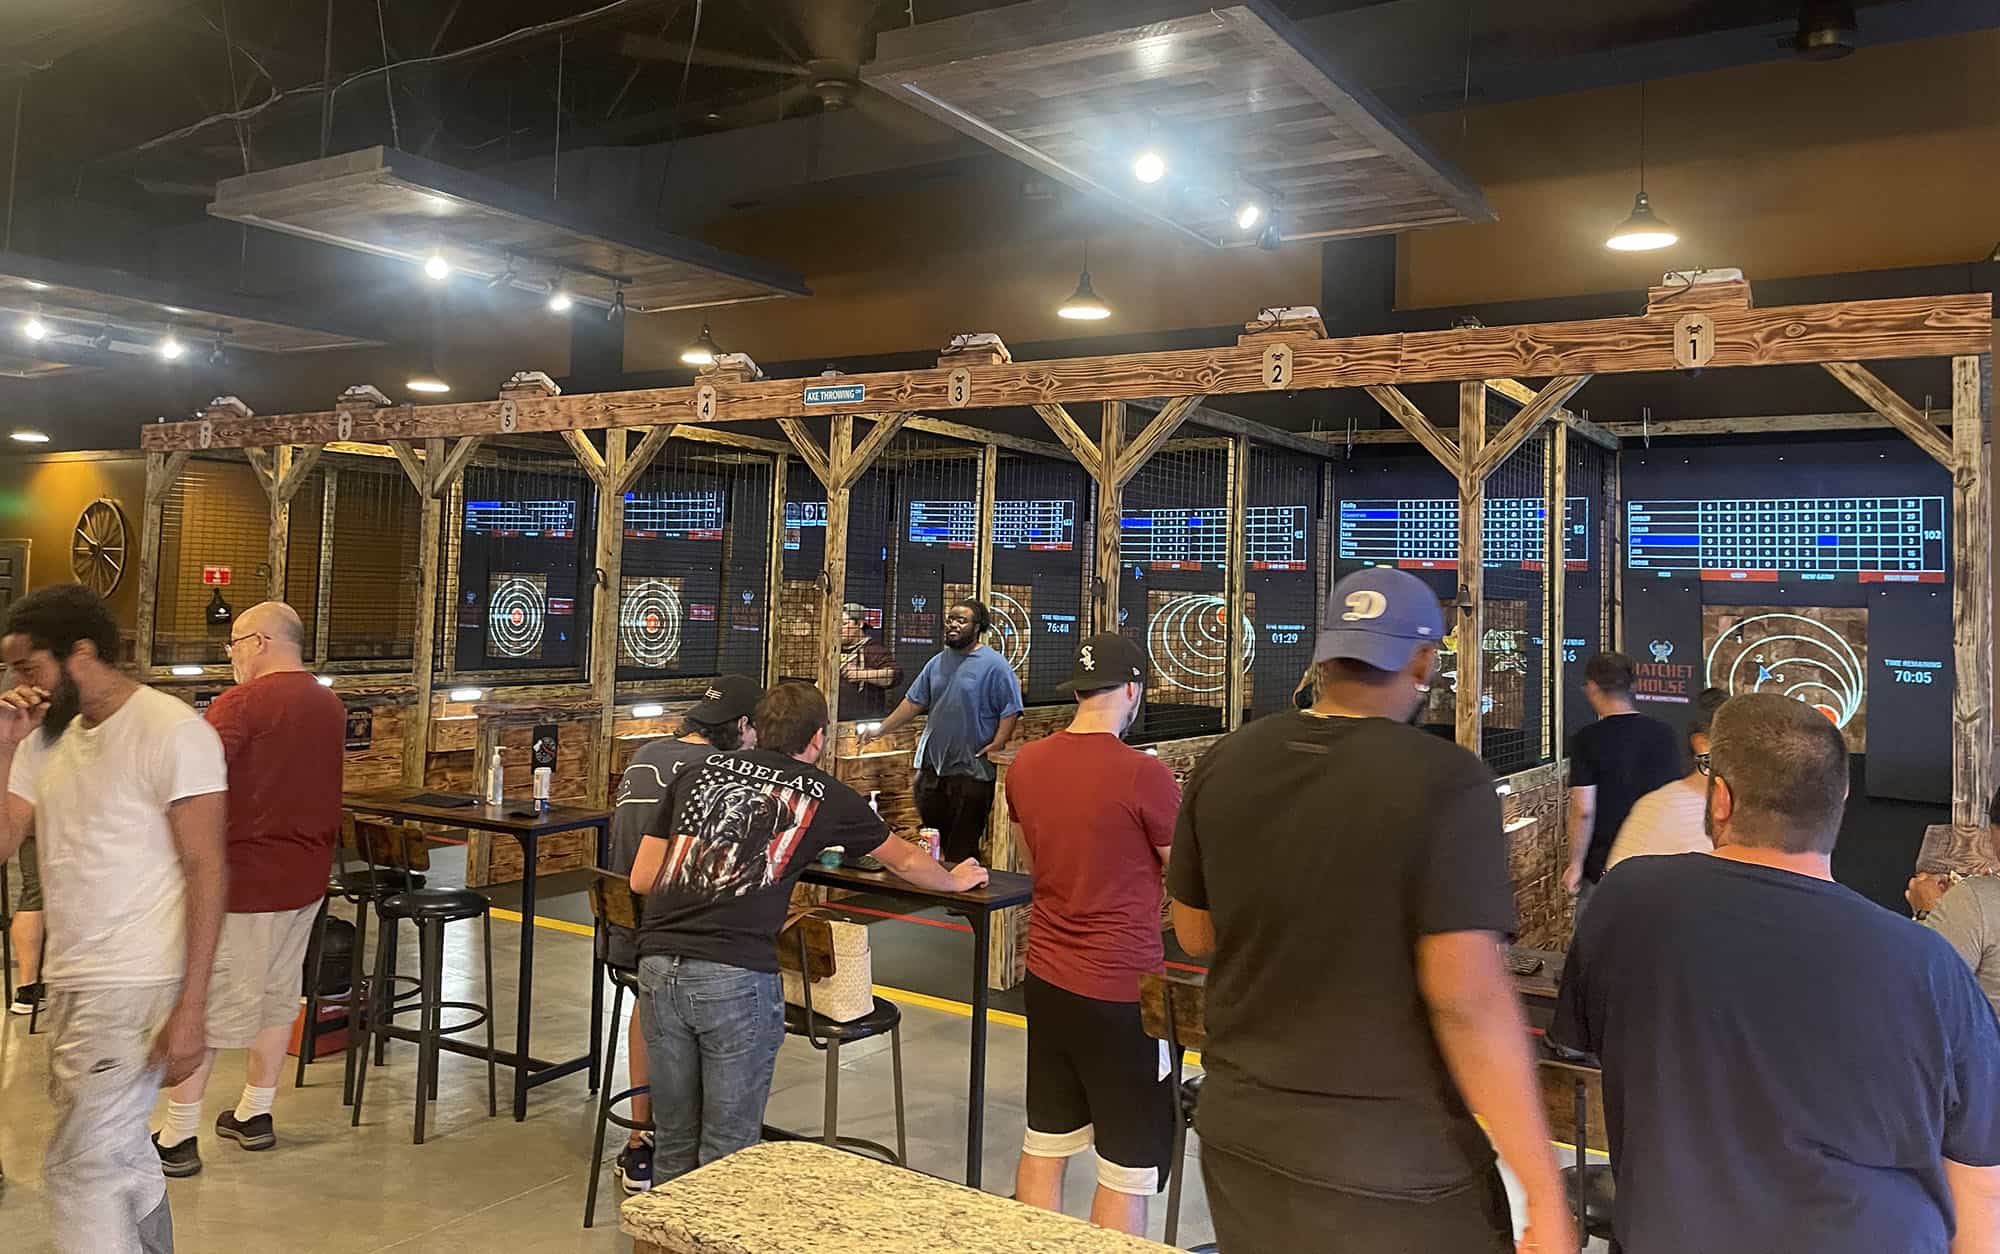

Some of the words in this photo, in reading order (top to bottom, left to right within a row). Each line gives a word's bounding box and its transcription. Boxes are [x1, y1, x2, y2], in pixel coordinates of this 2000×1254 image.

[1688, 338, 1697, 361] 1
[1271, 364, 1283, 383] 2
[806, 391, 820, 401] AXE
[821, 389, 855, 401] THROWING
[954, 386, 963, 402] 3
[702, 401, 710, 416] 4
[504, 414, 511, 427] 5
[1754, 653, 1764, 664] 2
[1775, 673, 1785, 683] 3
[1893, 669, 1933, 684] 70:05
[705, 753, 826, 798] CABELA'S
